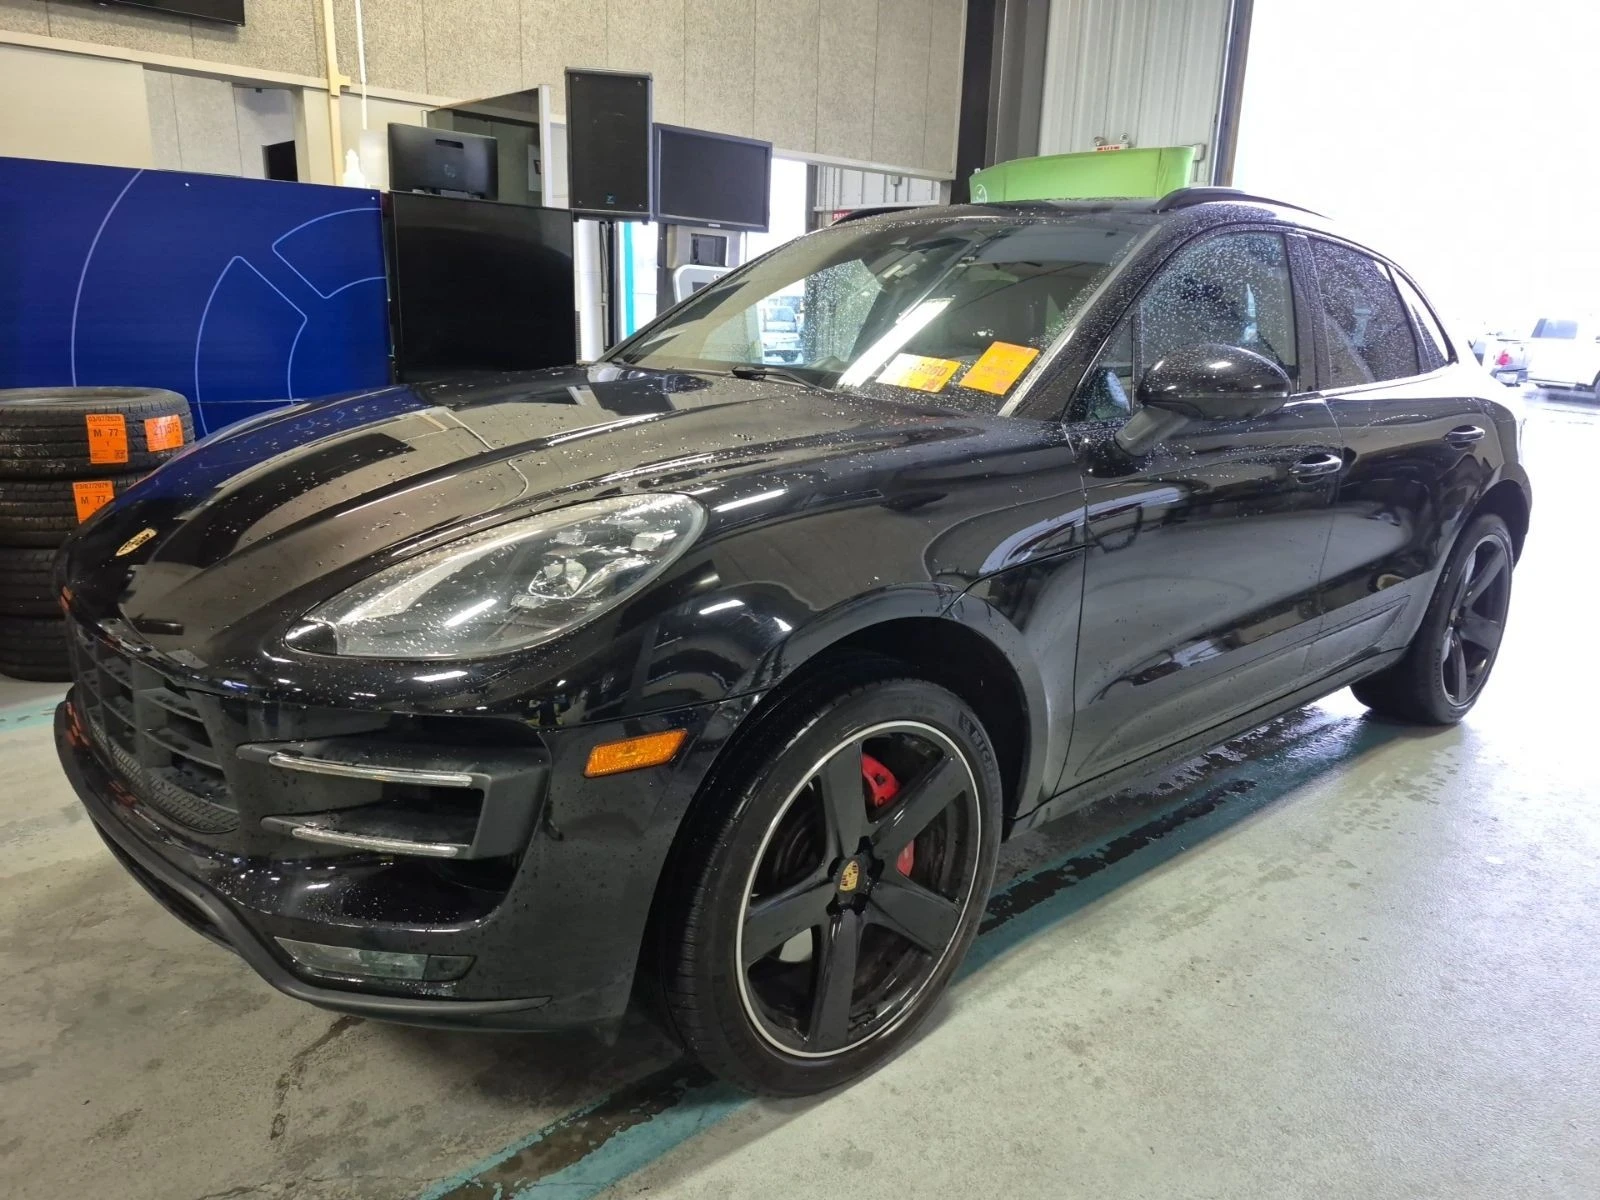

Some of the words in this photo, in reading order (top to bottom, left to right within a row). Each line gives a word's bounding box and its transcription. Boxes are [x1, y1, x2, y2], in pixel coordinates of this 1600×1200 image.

[93, 428, 102, 437] M
[108, 428, 118, 437] 77
[80, 496, 88, 504] M
[95, 495, 106, 504] 77
